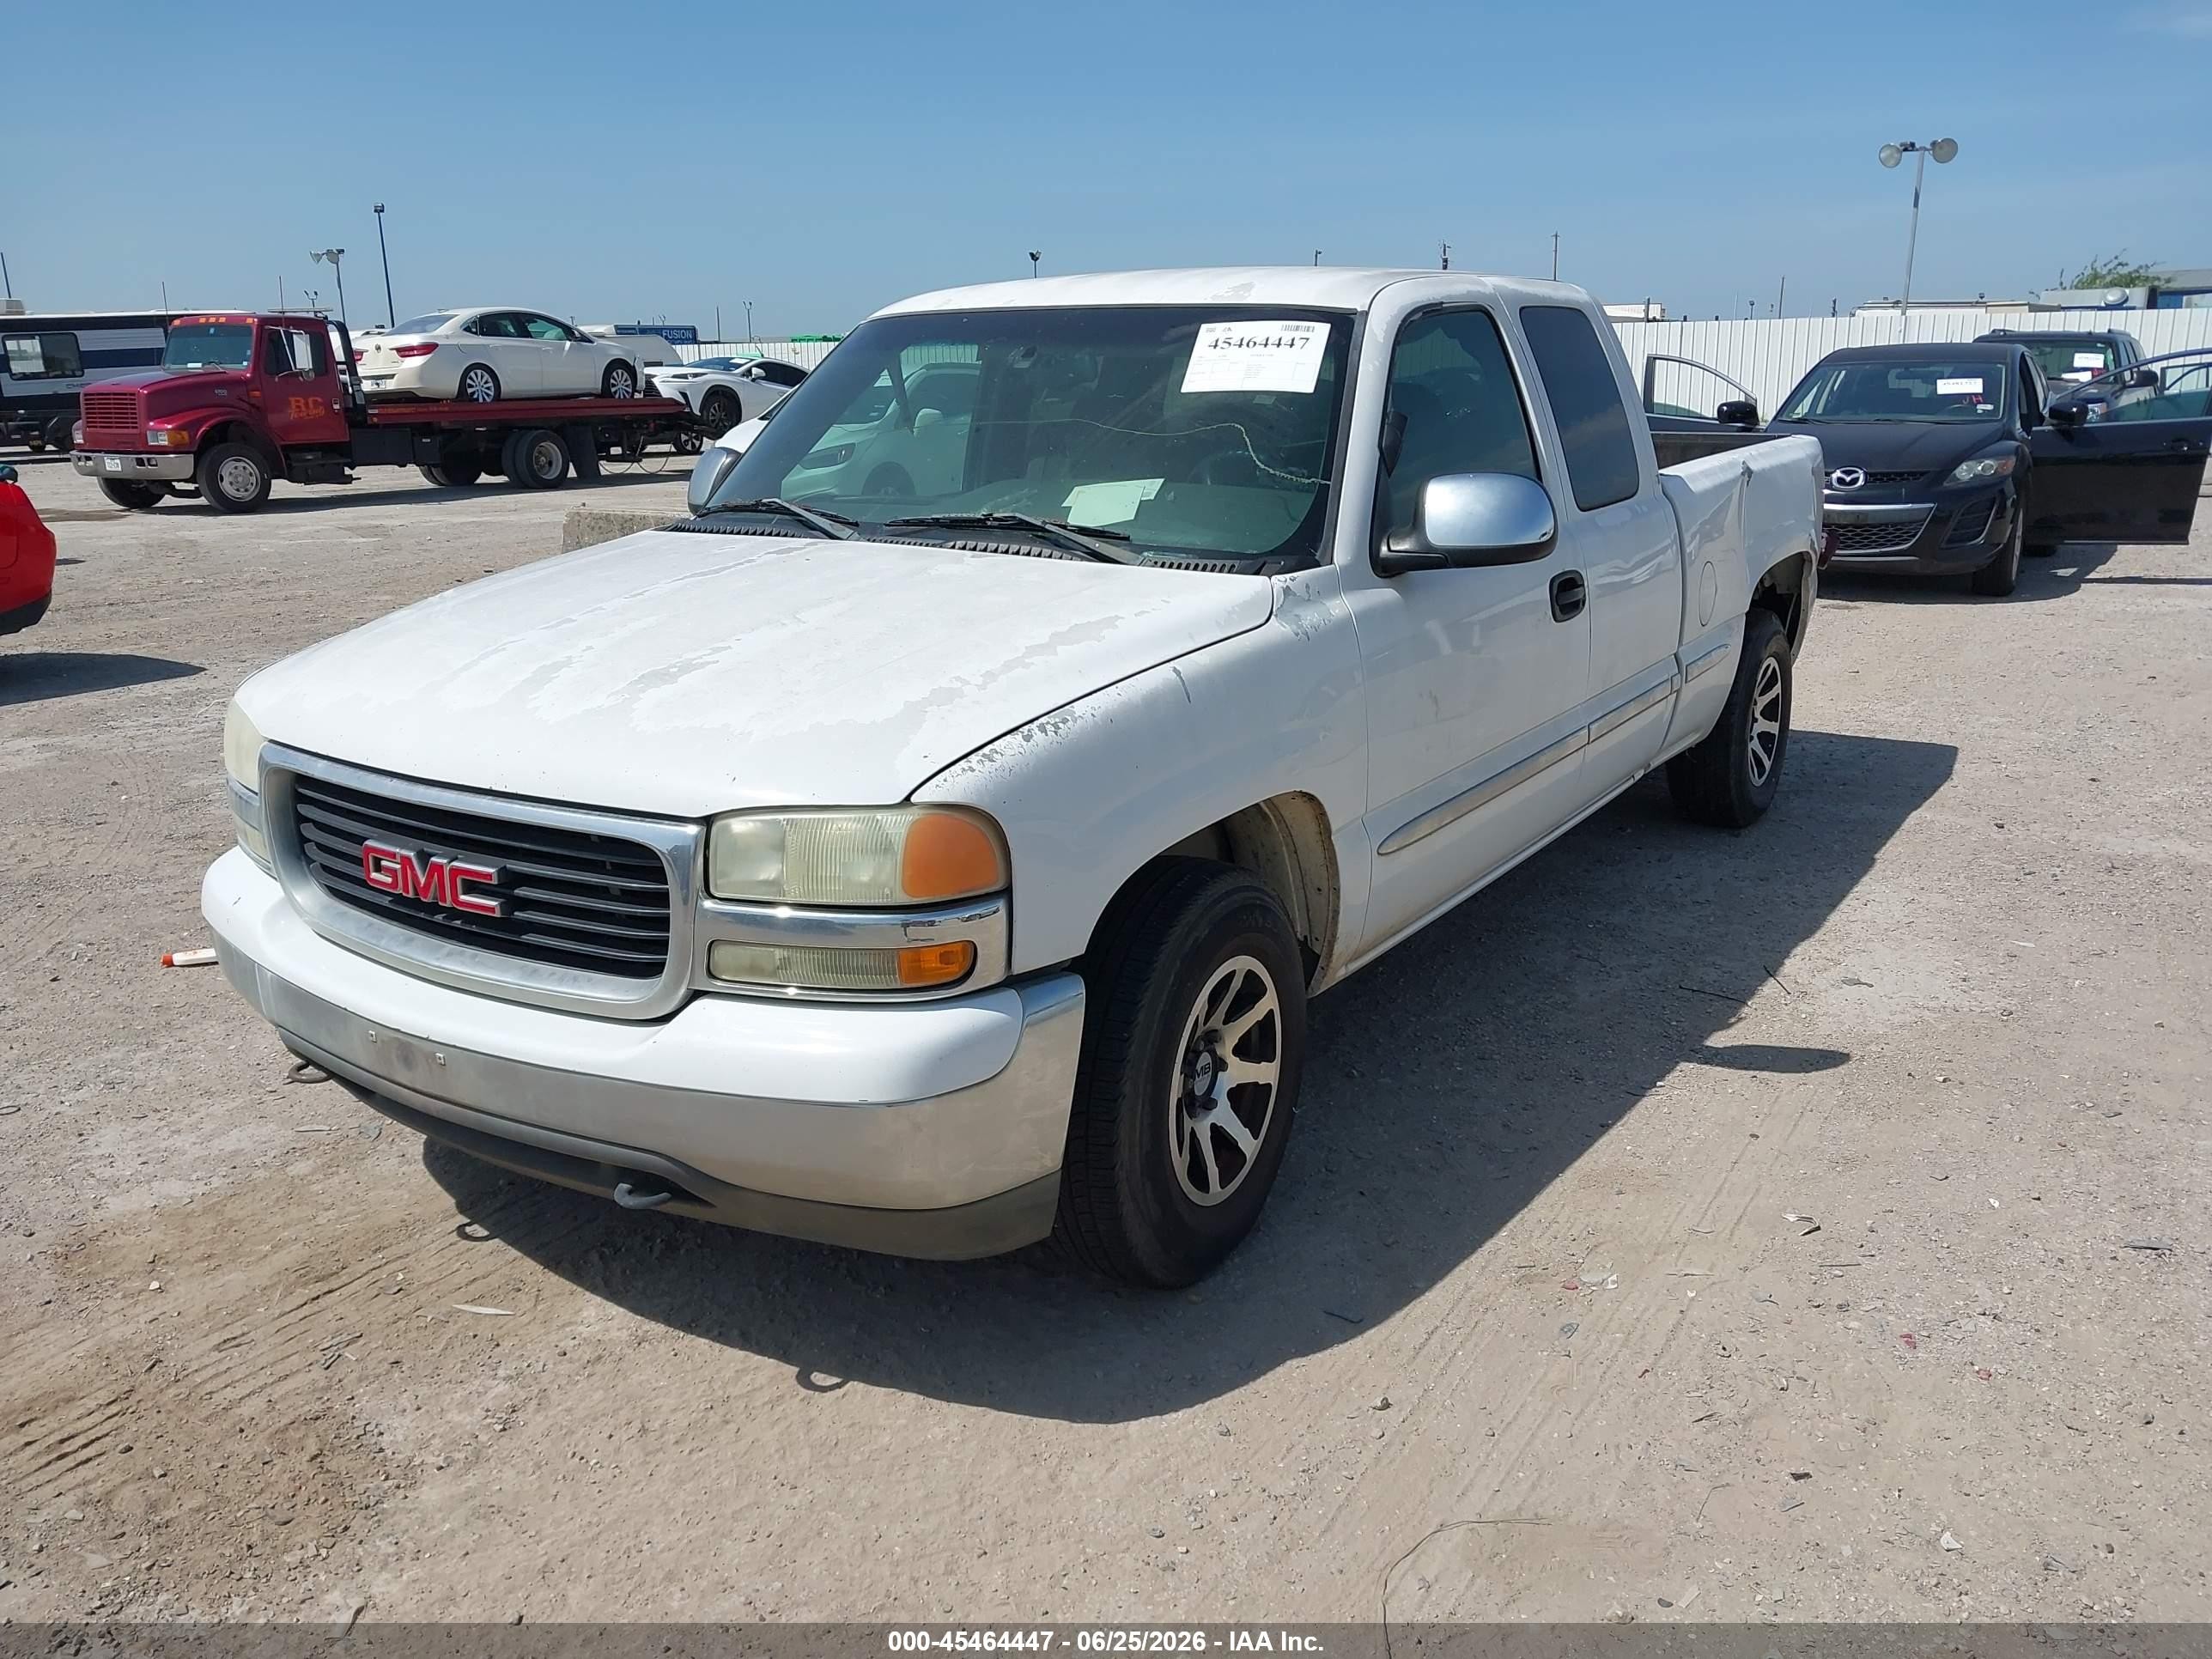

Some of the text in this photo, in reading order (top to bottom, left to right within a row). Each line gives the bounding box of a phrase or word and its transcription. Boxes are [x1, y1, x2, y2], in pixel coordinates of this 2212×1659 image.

[662, 329, 692, 339] FUSION
[1207, 336, 1310, 349] 45464447
[362, 839, 503, 918] GMC
[1194, 1061, 1211, 1079] MB
